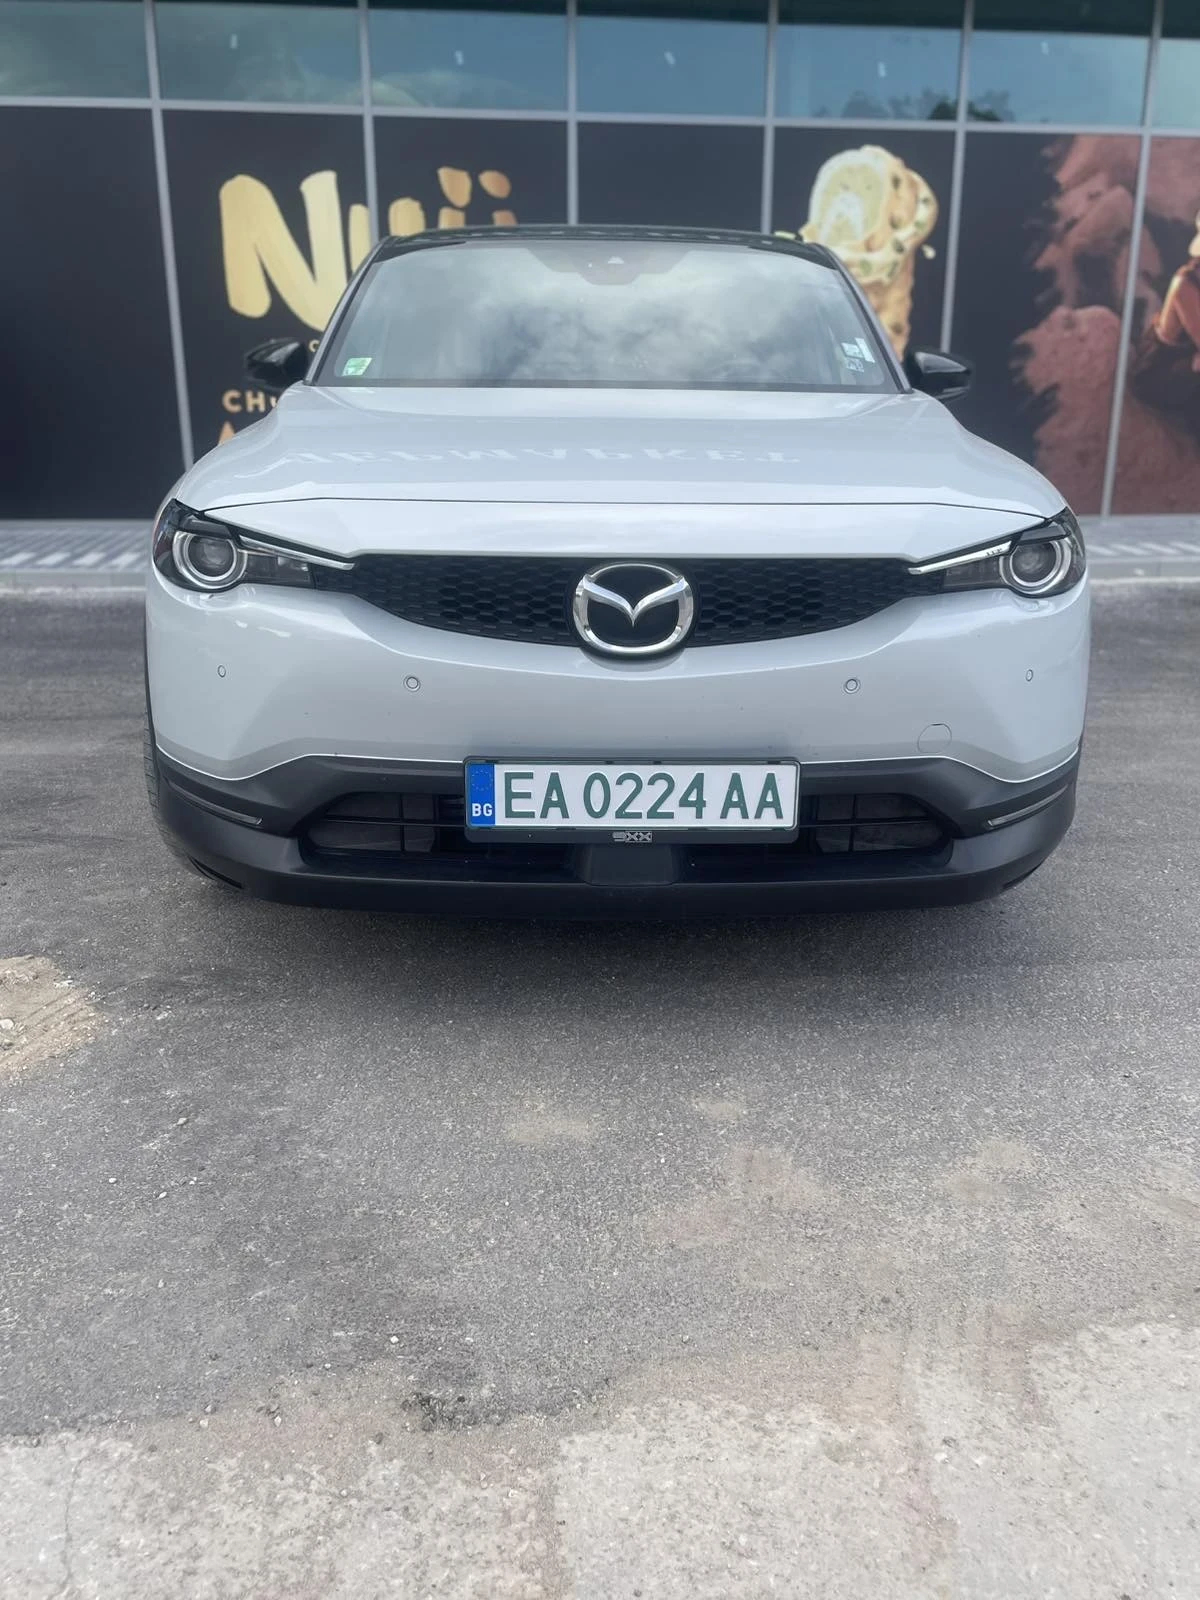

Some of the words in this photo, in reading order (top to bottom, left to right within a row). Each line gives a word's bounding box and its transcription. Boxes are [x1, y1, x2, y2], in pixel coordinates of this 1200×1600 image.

[222, 389, 278, 413] CH
[504, 772, 570, 819] EA
[583, 772, 706, 819] 0224
[720, 772, 784, 819] AA
[472, 803, 493, 817] BG
